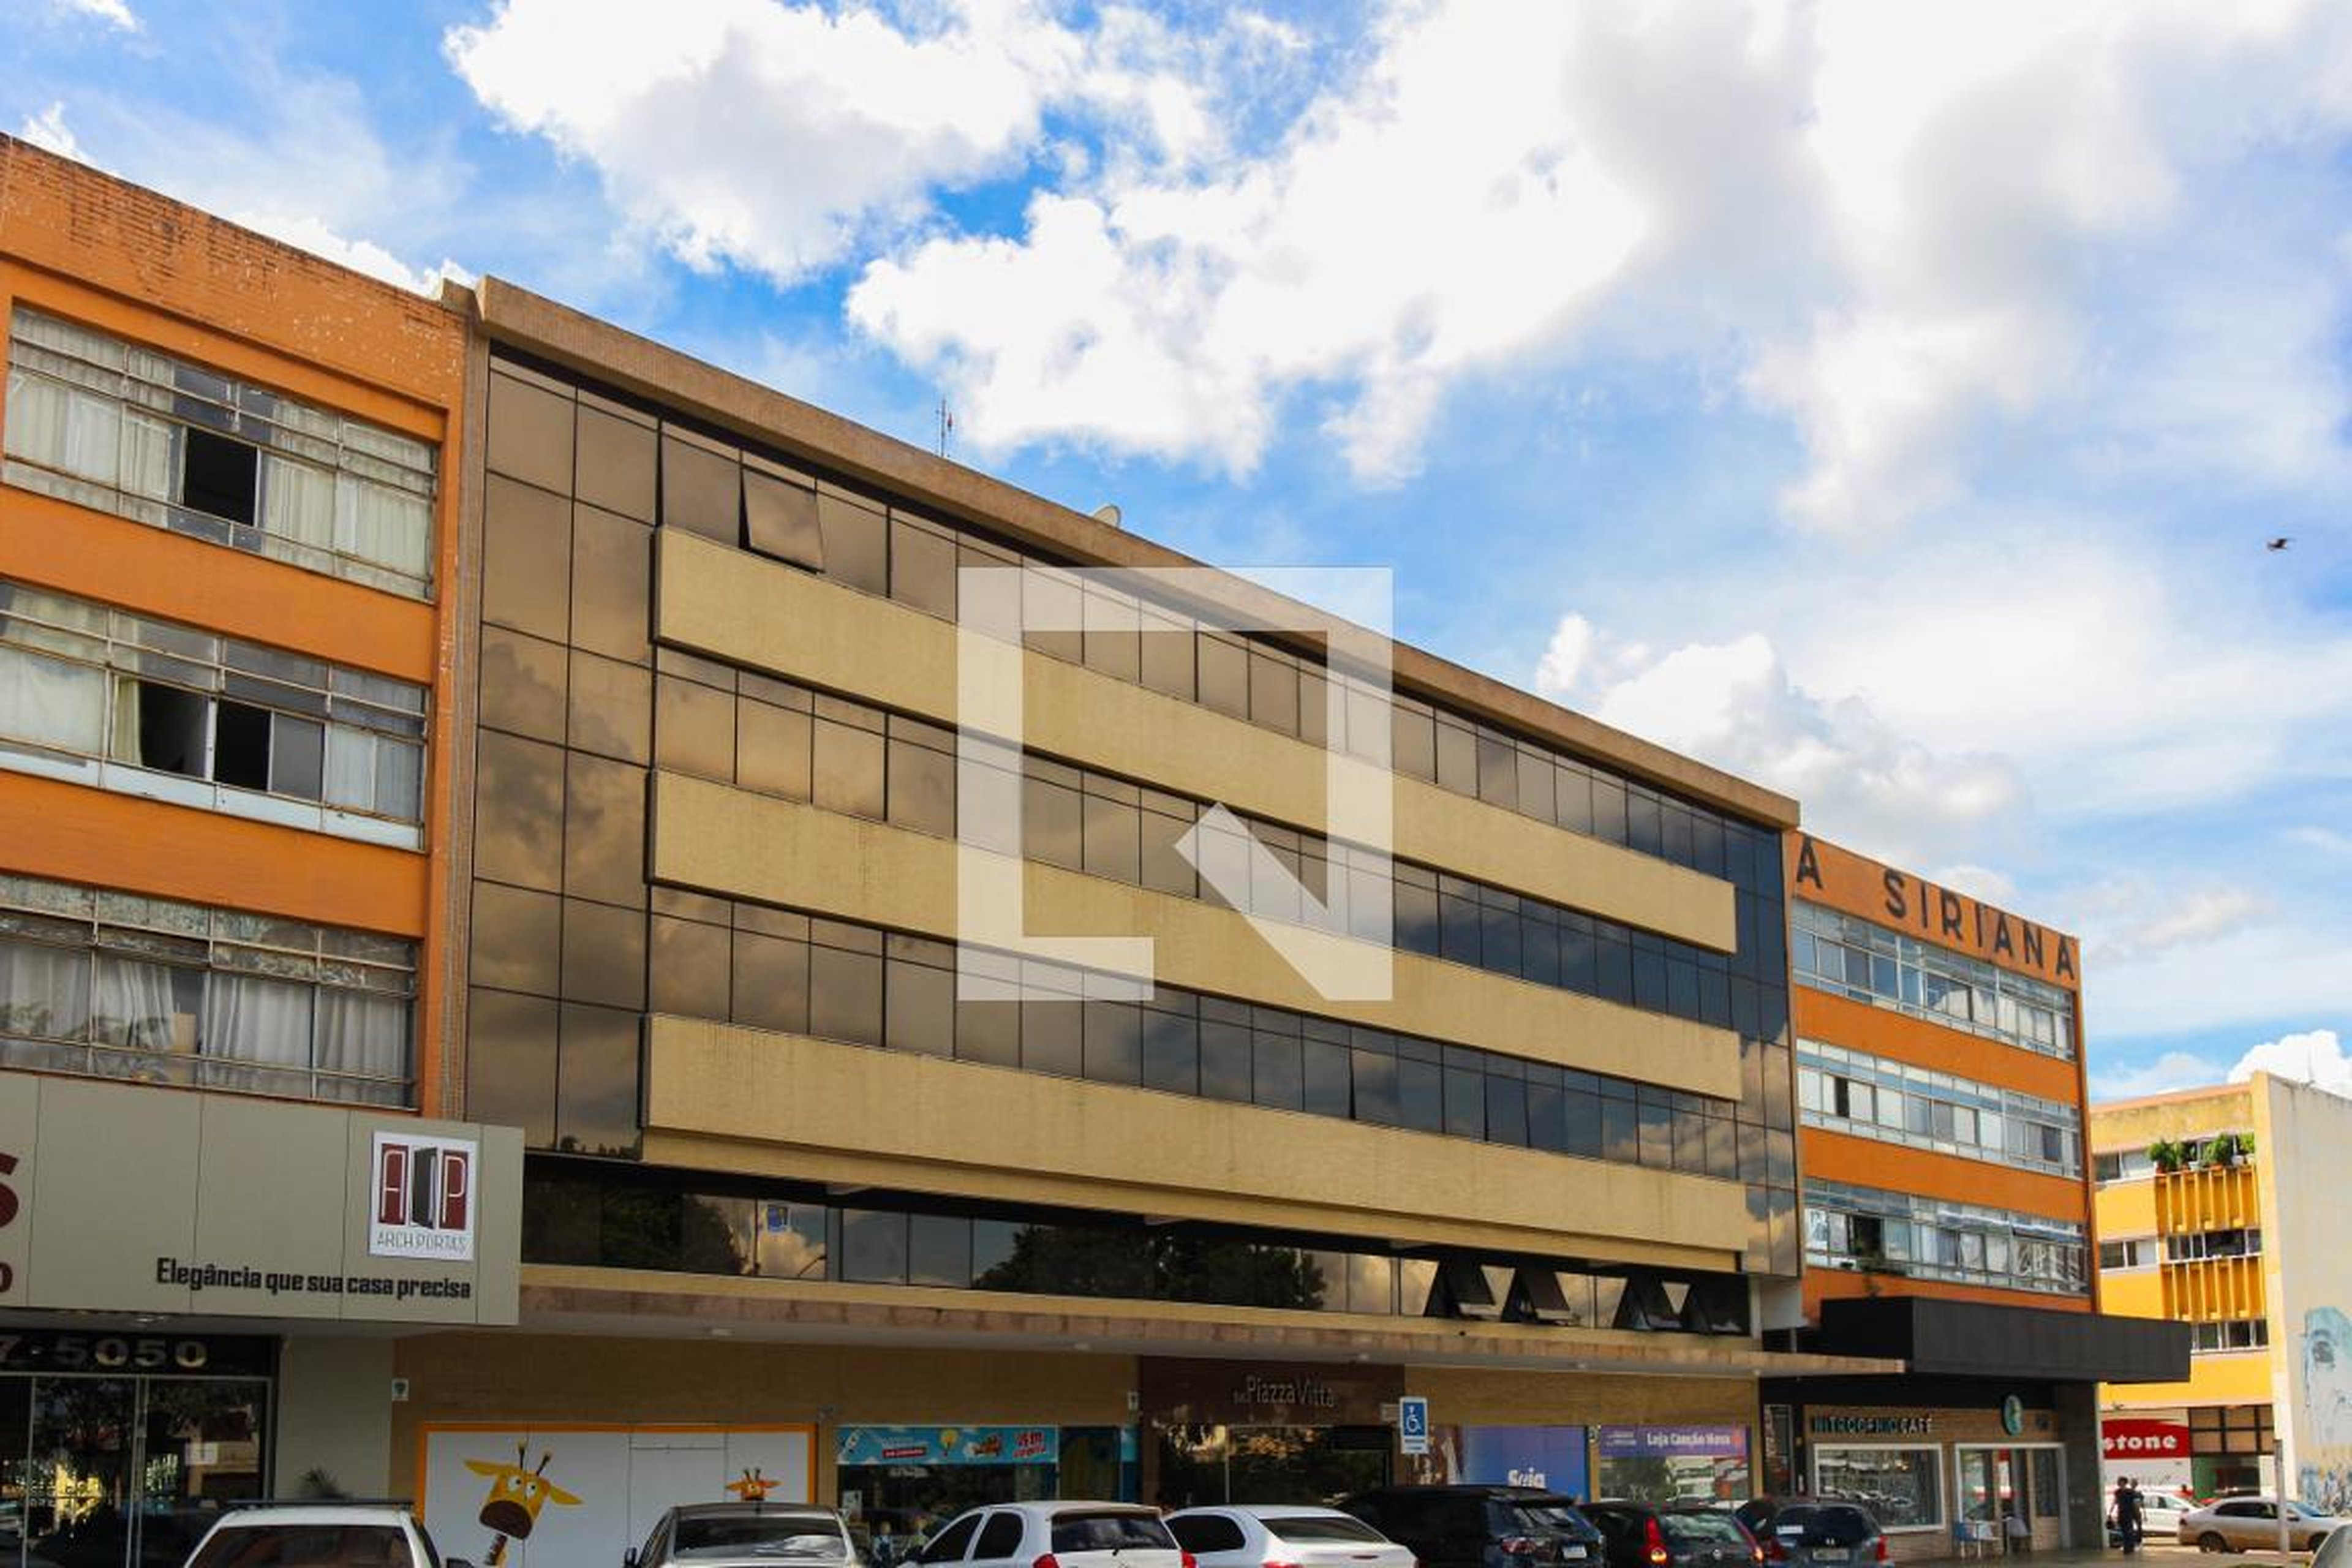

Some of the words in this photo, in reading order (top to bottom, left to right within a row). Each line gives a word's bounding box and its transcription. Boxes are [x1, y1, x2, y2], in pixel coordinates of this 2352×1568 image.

[1883, 867, 2075, 979] SIRIANA
[157, 1257, 262, 1291] Elegância
[266, 1273, 304, 1295] que
[307, 1275, 344, 1293] sua
[347, 1277, 393, 1295] casa
[396, 1278, 470, 1300] precisa
[1247, 1375, 1296, 1404] Piazza
